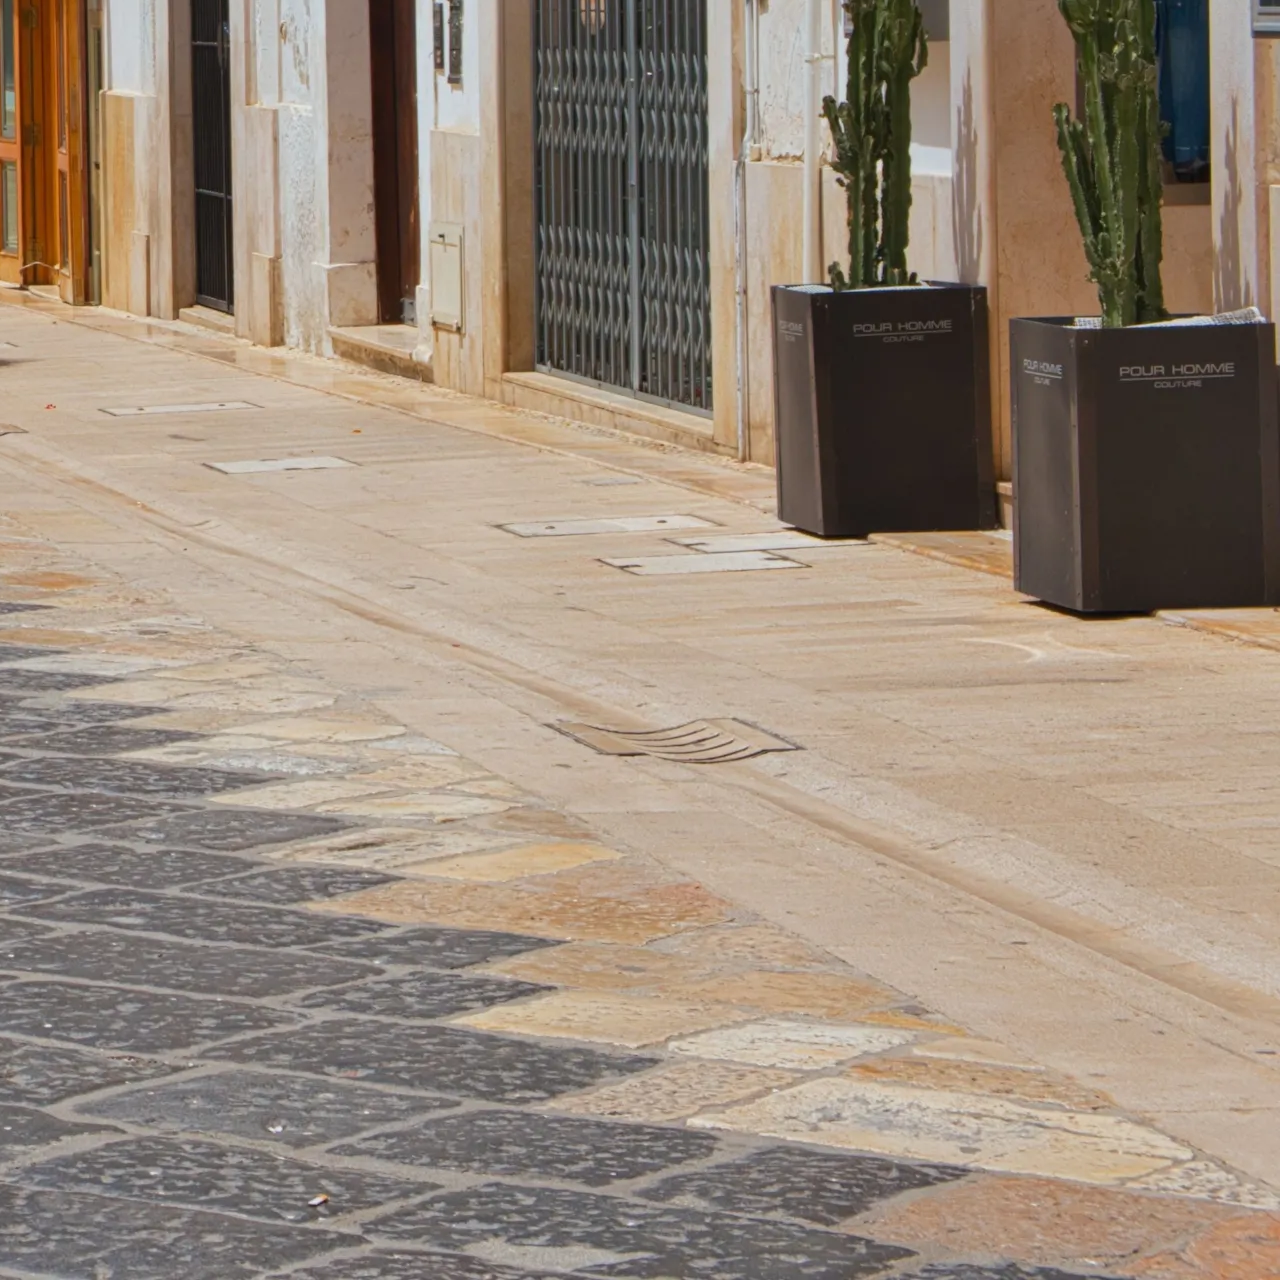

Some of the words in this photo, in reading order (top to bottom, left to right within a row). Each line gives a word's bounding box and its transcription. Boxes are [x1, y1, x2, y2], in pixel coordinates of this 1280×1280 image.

[853, 323, 893, 333] POUR
[898, 320, 952, 330] HOMME
[883, 335, 925, 343] COUTURE
[1119, 365, 1165, 377] POUR
[1172, 362, 1235, 374] HOMME
[1154, 380, 1202, 388] COUTURE
